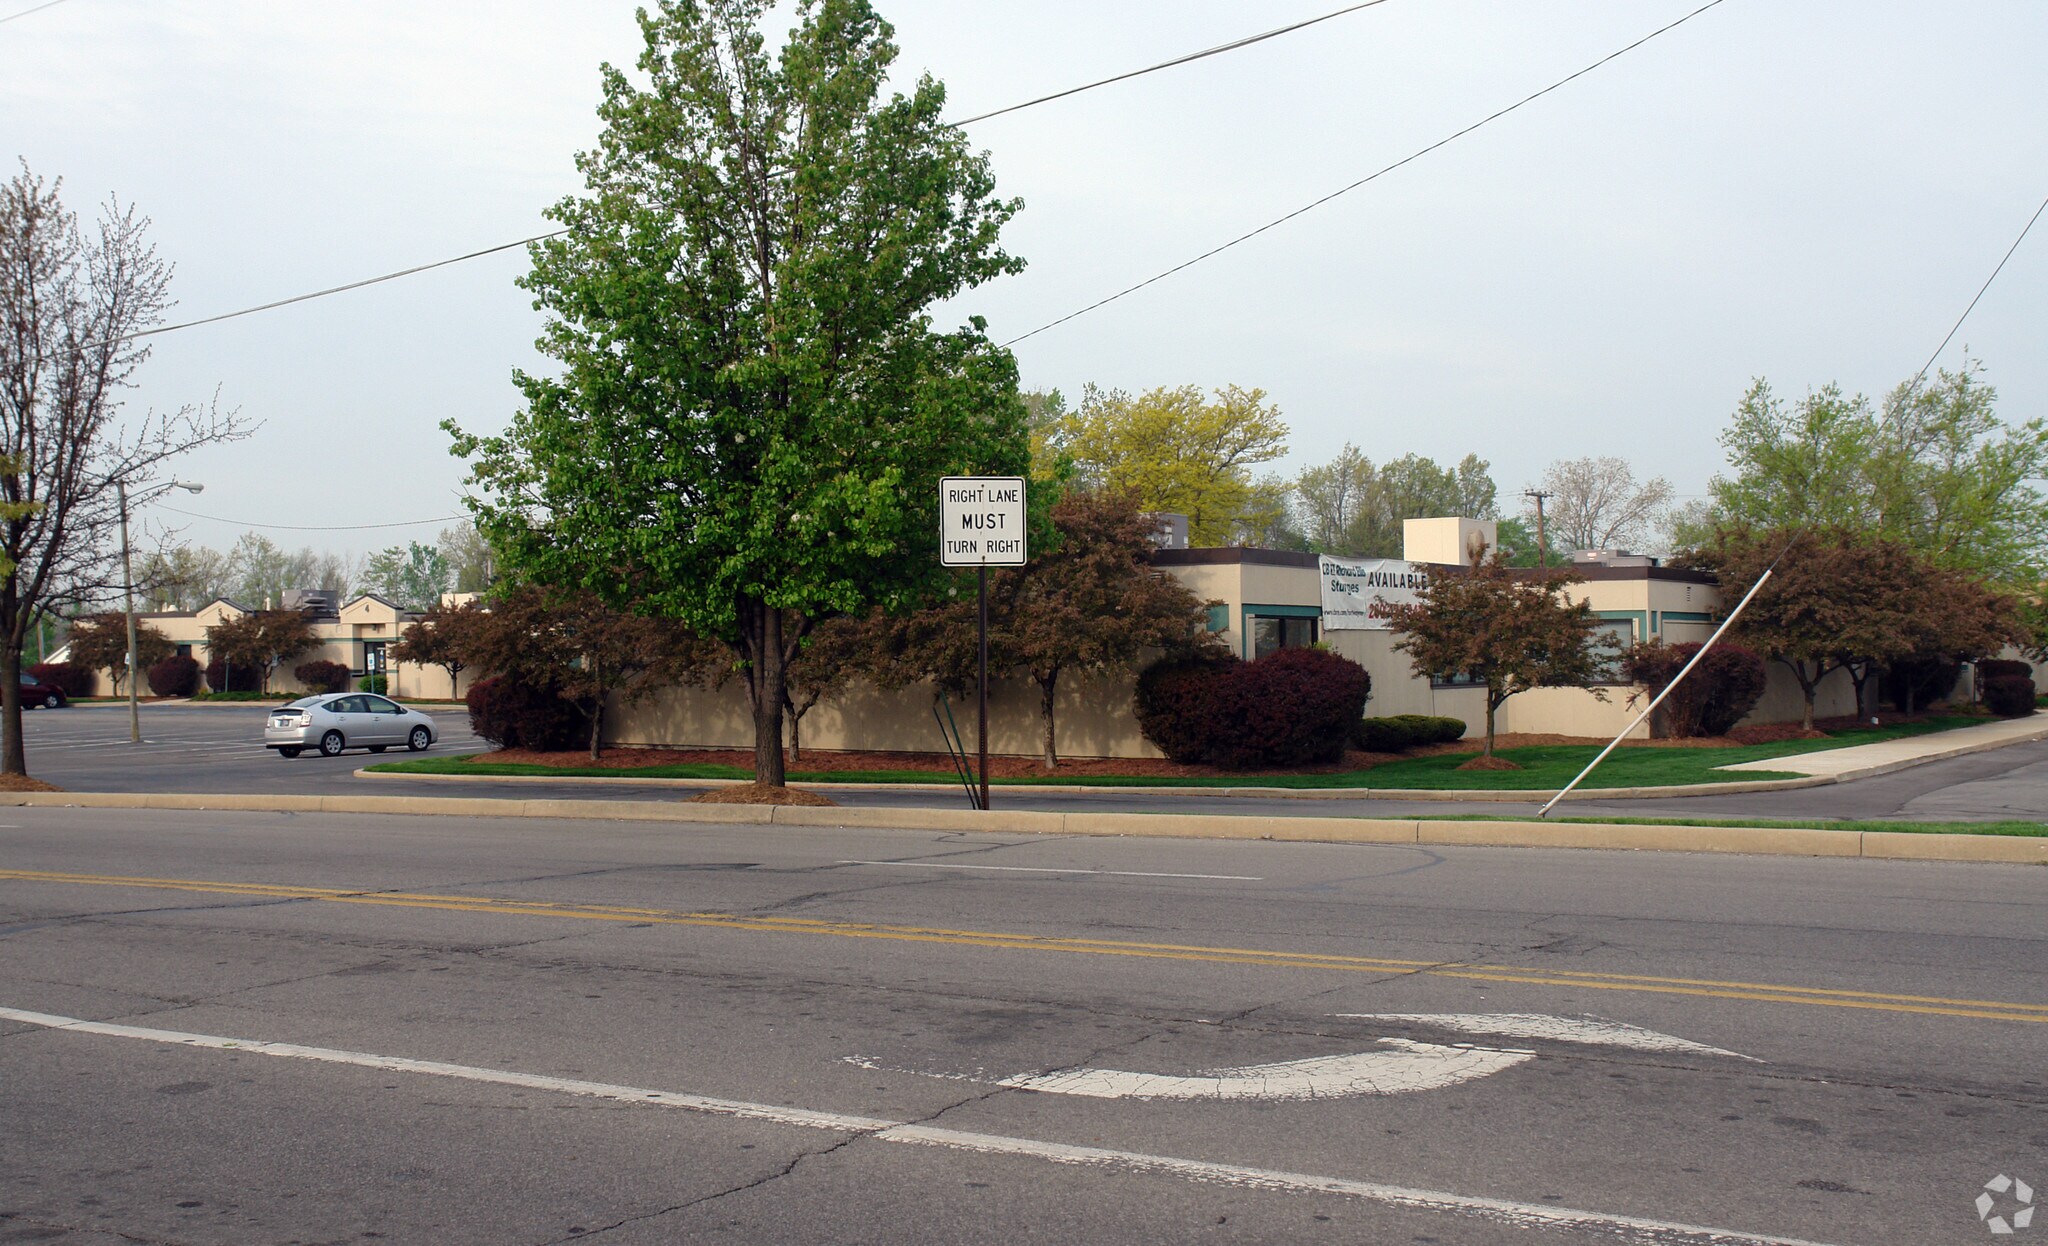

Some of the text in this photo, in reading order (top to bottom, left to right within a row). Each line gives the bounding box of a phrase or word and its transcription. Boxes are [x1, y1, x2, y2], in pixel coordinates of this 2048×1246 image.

[949, 489, 1018, 503] RIGHT LANE
[962, 513, 1006, 530] MUST
[947, 540, 1020, 553] TURN RIGHT
[1331, 580, 1359, 595] Sturges
[1367, 572, 1428, 590] AVAILABLE
[365, 604, 370, 613] 4
